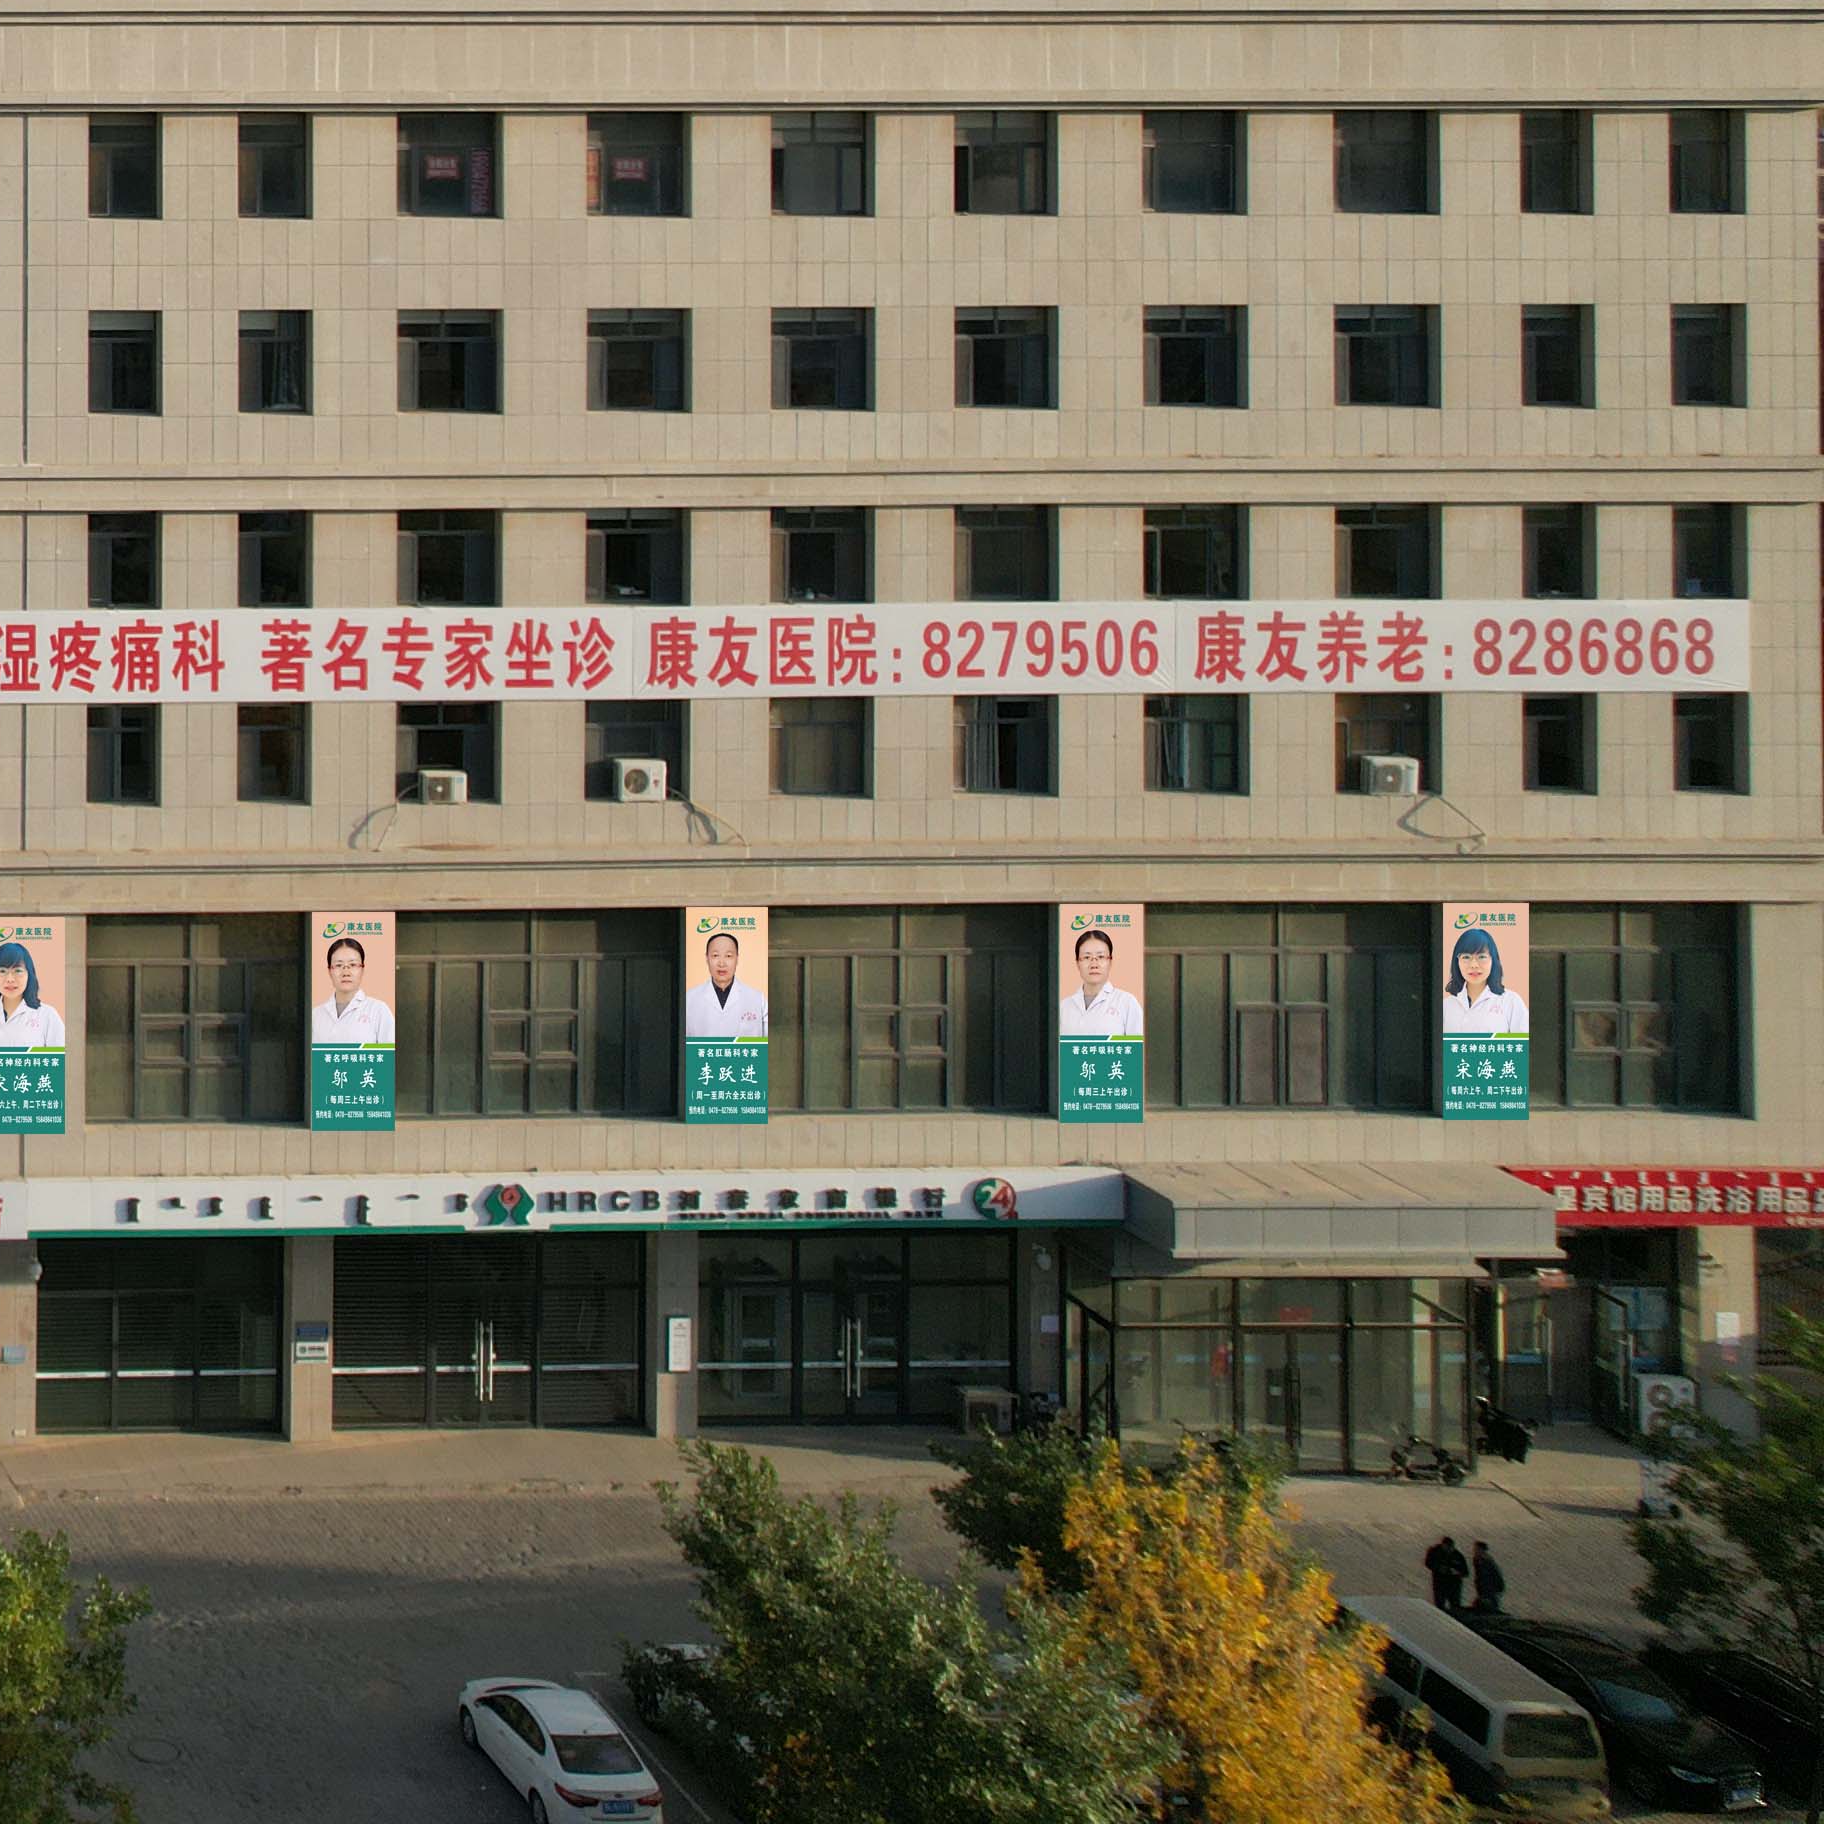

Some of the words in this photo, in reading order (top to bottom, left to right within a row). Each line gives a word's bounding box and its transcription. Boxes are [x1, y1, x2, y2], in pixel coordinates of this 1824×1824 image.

[261, 616, 615, 692] 著名专家坐诊
[324, 1053, 384, 1063] 著名呼吸科专家
[697, 1048, 759, 1058] 著名肛肠科专家
[1072, 1045, 1132, 1055] 著名呼吸科专家
[1450, 1043, 1524, 1053] 著名神经内科专家
[697, 1062, 758, 1086] 李跃进
[1455, 1058, 1518, 1080] 宋海燕
[548, 1190, 661, 1212] HRCB
[980, 1185, 1011, 1210] 24
